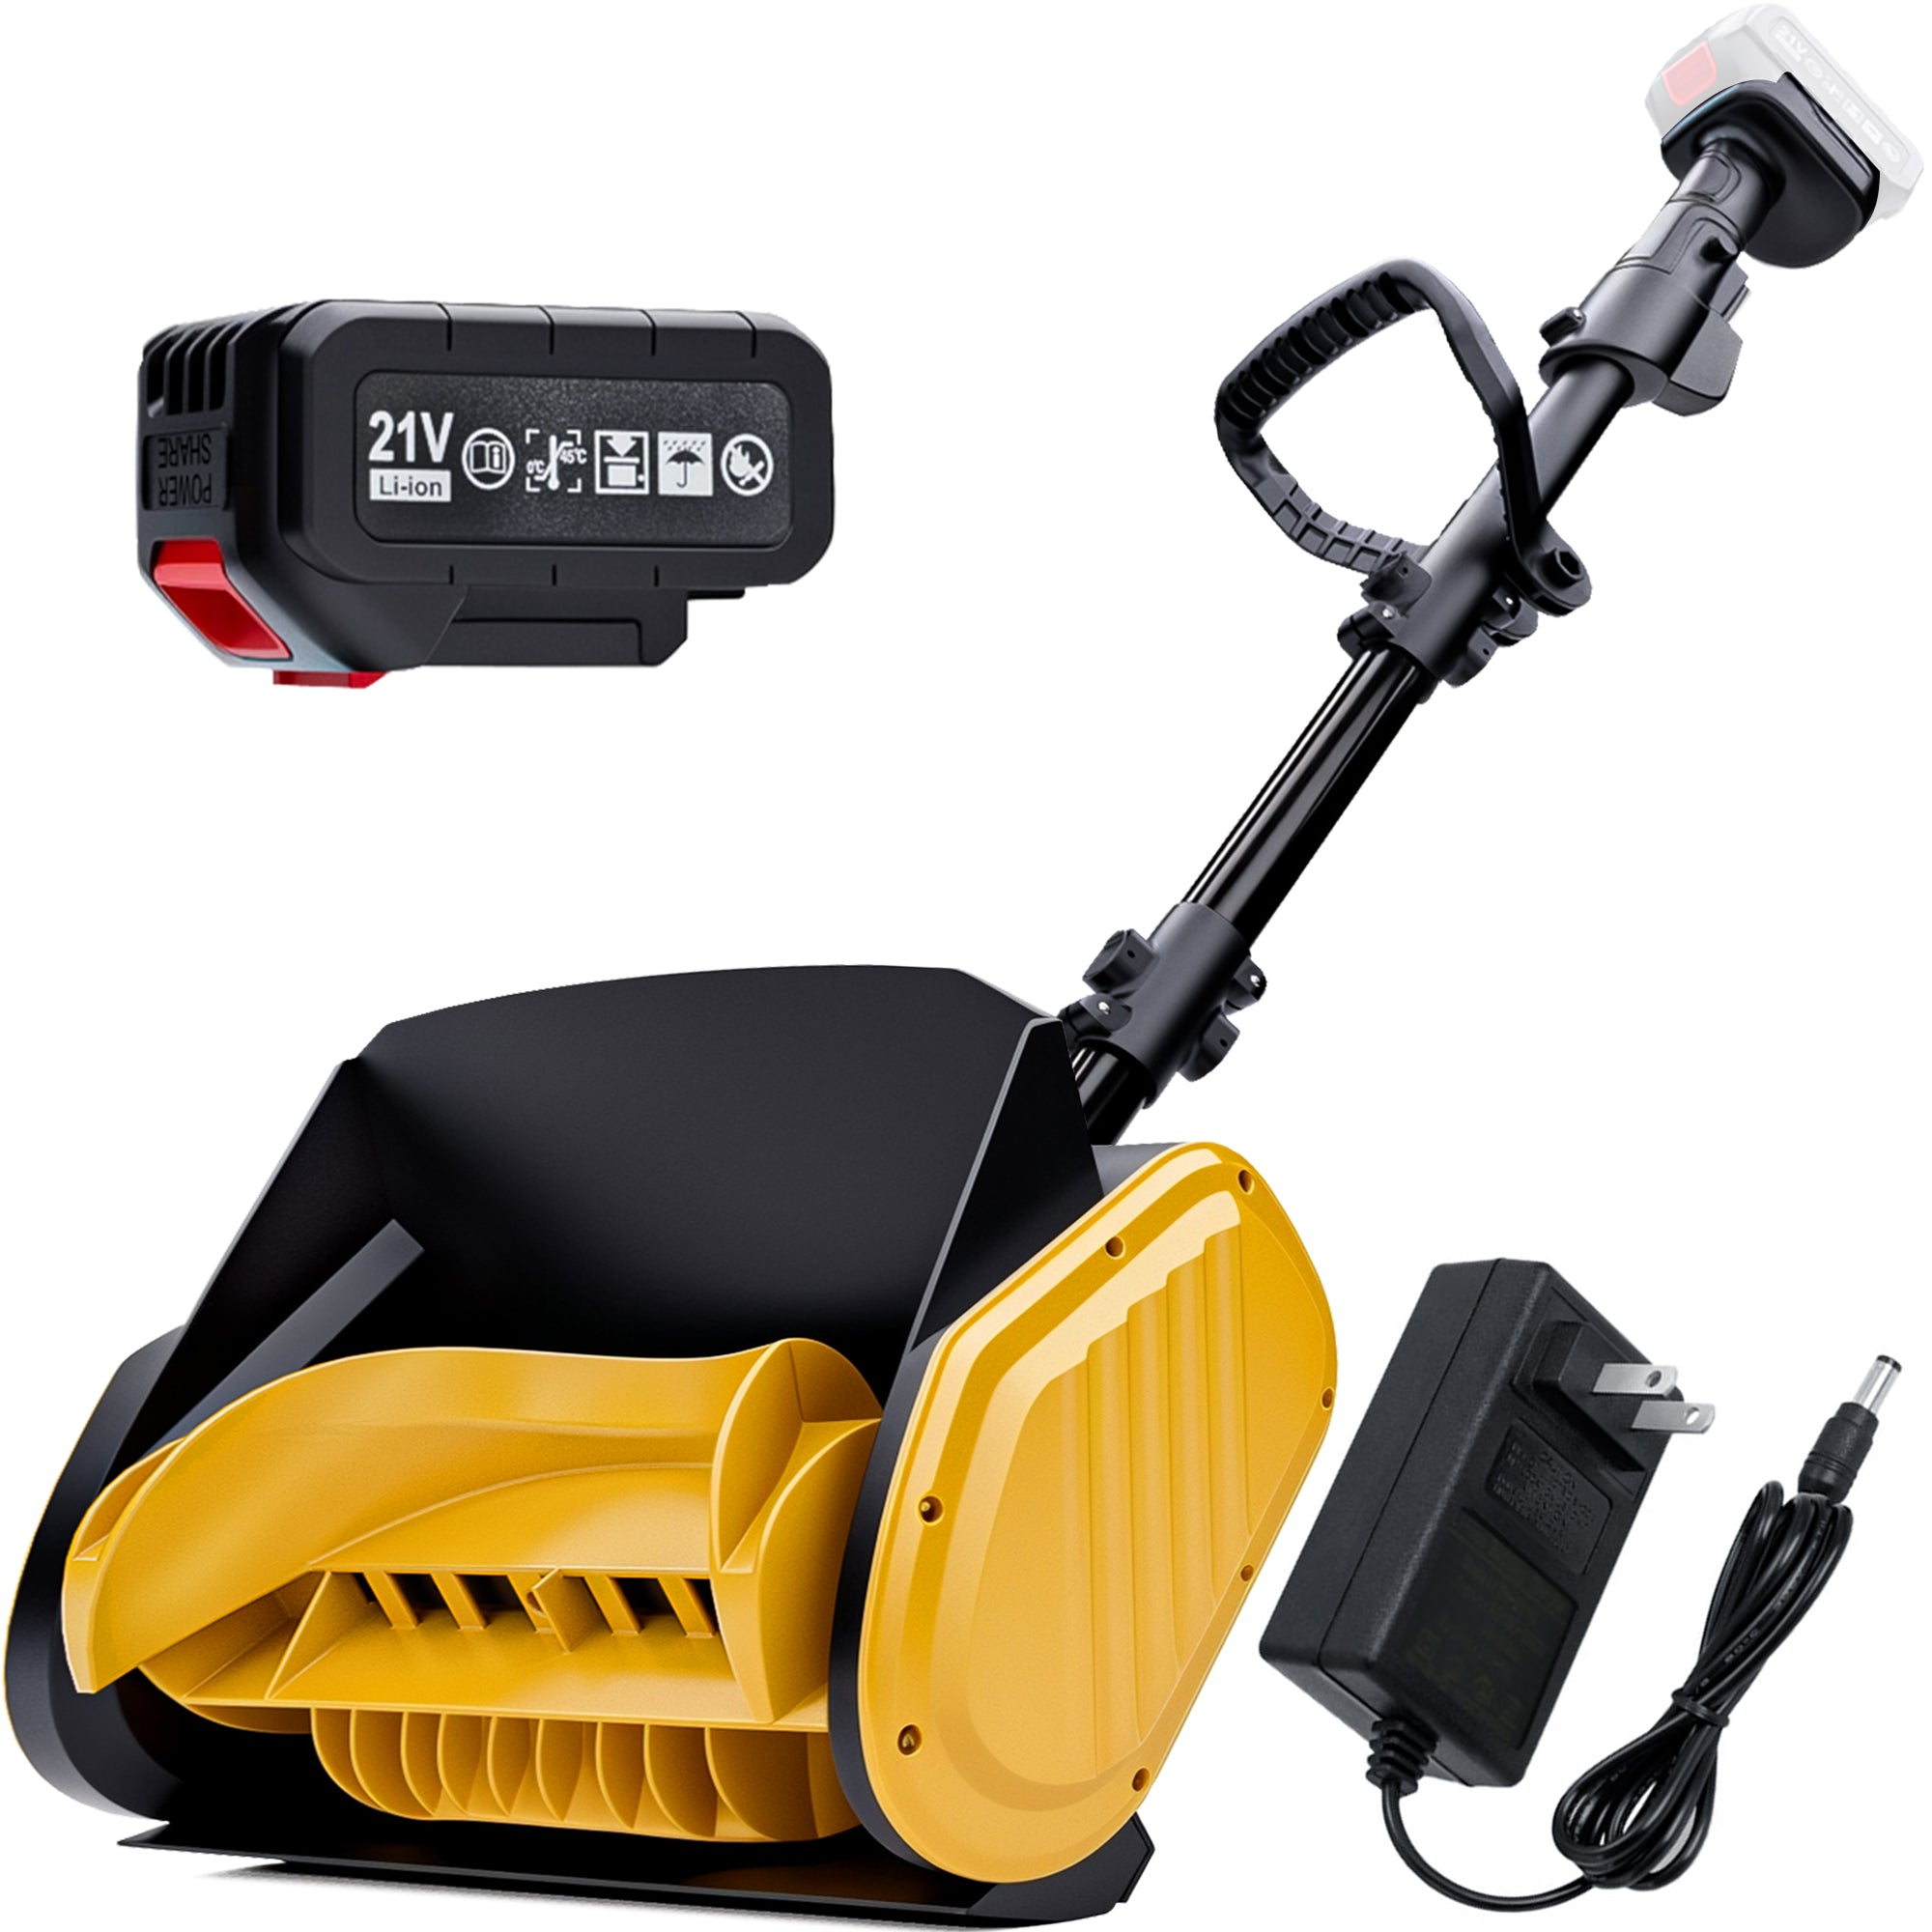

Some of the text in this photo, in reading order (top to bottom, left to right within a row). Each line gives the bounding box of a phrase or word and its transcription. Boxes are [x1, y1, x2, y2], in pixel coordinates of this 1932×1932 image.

[157, 433, 212, 469] SHARE
[368, 410, 455, 463] 21V
[157, 472, 212, 507] POWER
[380, 474, 442, 497] Li-ion
